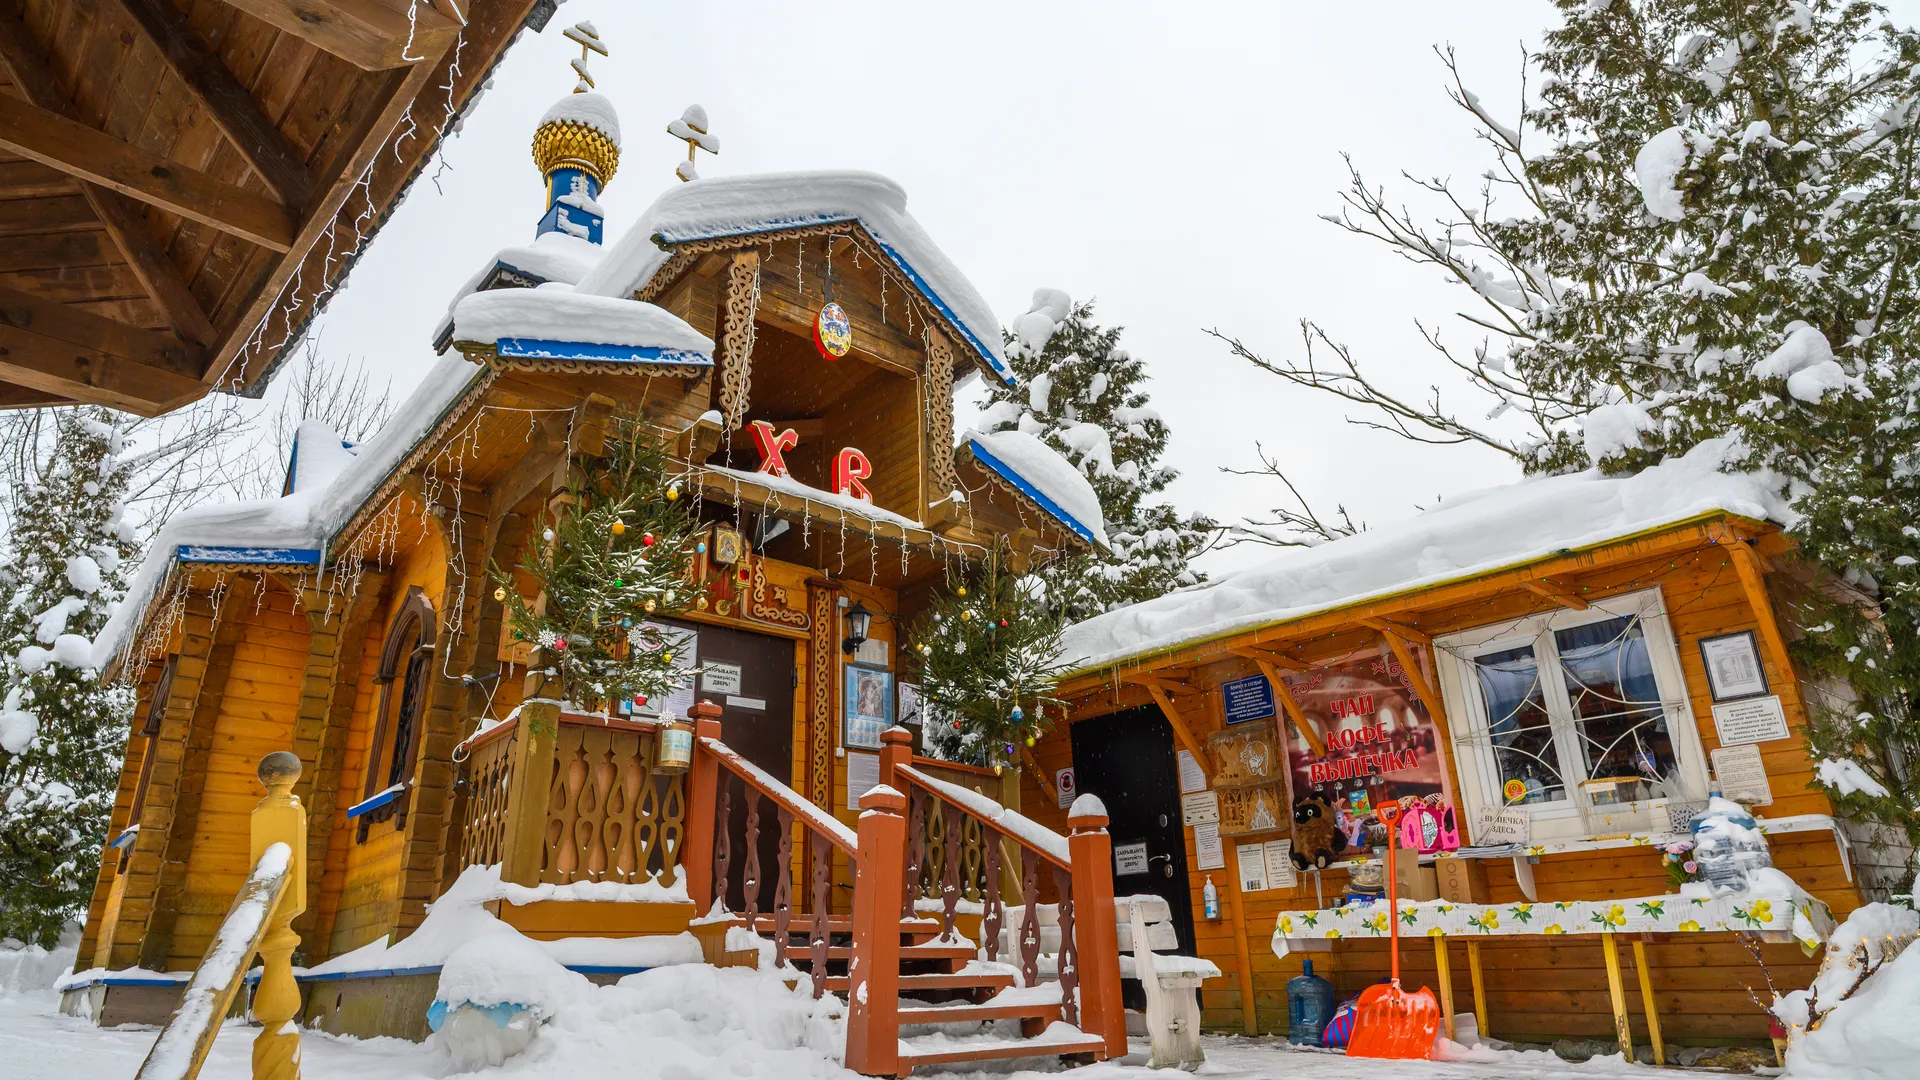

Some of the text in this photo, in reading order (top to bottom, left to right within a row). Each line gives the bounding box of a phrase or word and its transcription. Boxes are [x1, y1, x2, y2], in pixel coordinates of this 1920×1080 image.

[1330, 691, 1375, 719] ЧАЙ
[1326, 722, 1391, 751] КОФЕ
[1310, 748, 1419, 783] ВЫПЕЧКА
[1491, 825, 1516, 834] ЗДЕСЬ
